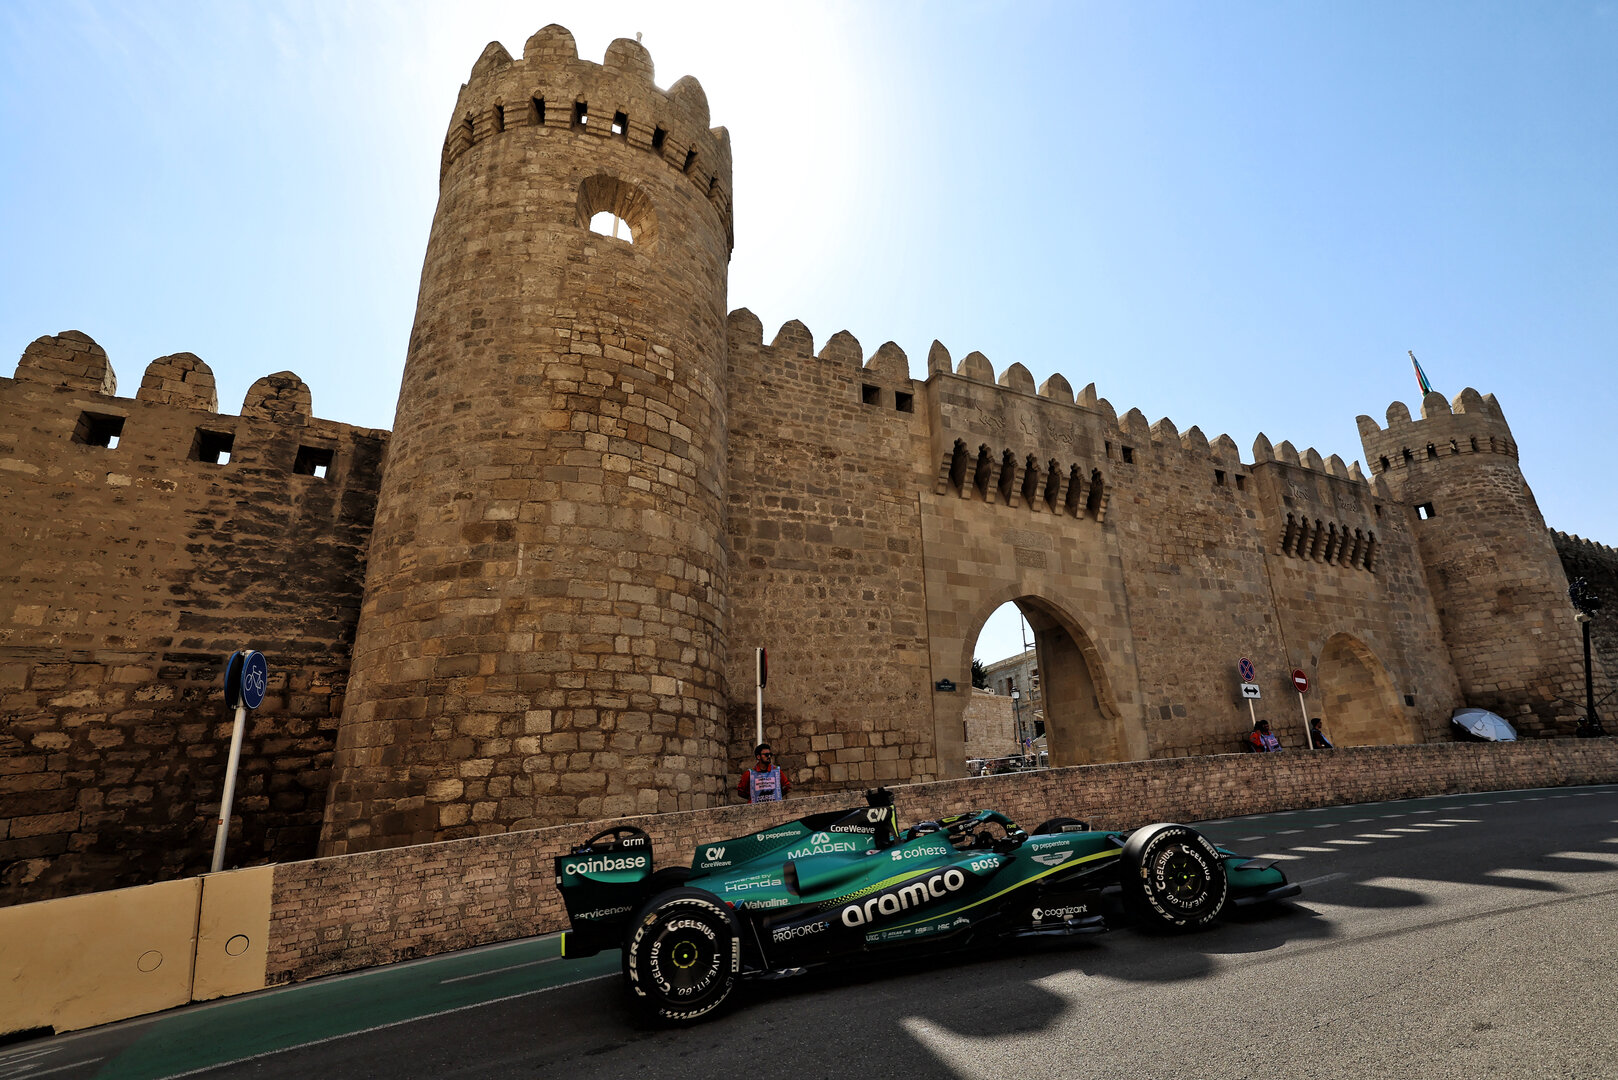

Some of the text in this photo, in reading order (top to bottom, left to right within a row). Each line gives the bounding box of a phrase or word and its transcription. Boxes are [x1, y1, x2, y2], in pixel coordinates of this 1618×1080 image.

[766, 830, 801, 840] pepperstone
[830, 825, 876, 834] CoreWeave
[622, 838, 645, 847] arm
[1039, 840, 1070, 850] pepperstone
[787, 841, 856, 860] MAADEN
[903, 845, 947, 859] cohere
[565, 856, 646, 876] coinbase
[700, 860, 732, 869] CoreWeave
[970, 857, 1000, 872] BOSS
[724, 875, 760, 885] Powered
[725, 879, 782, 893] Honda
[841, 869, 965, 928] aramco
[574, 905, 633, 920] servicenow
[1044, 904, 1088, 918] cognizant
[629, 927, 645, 982] ZERO
